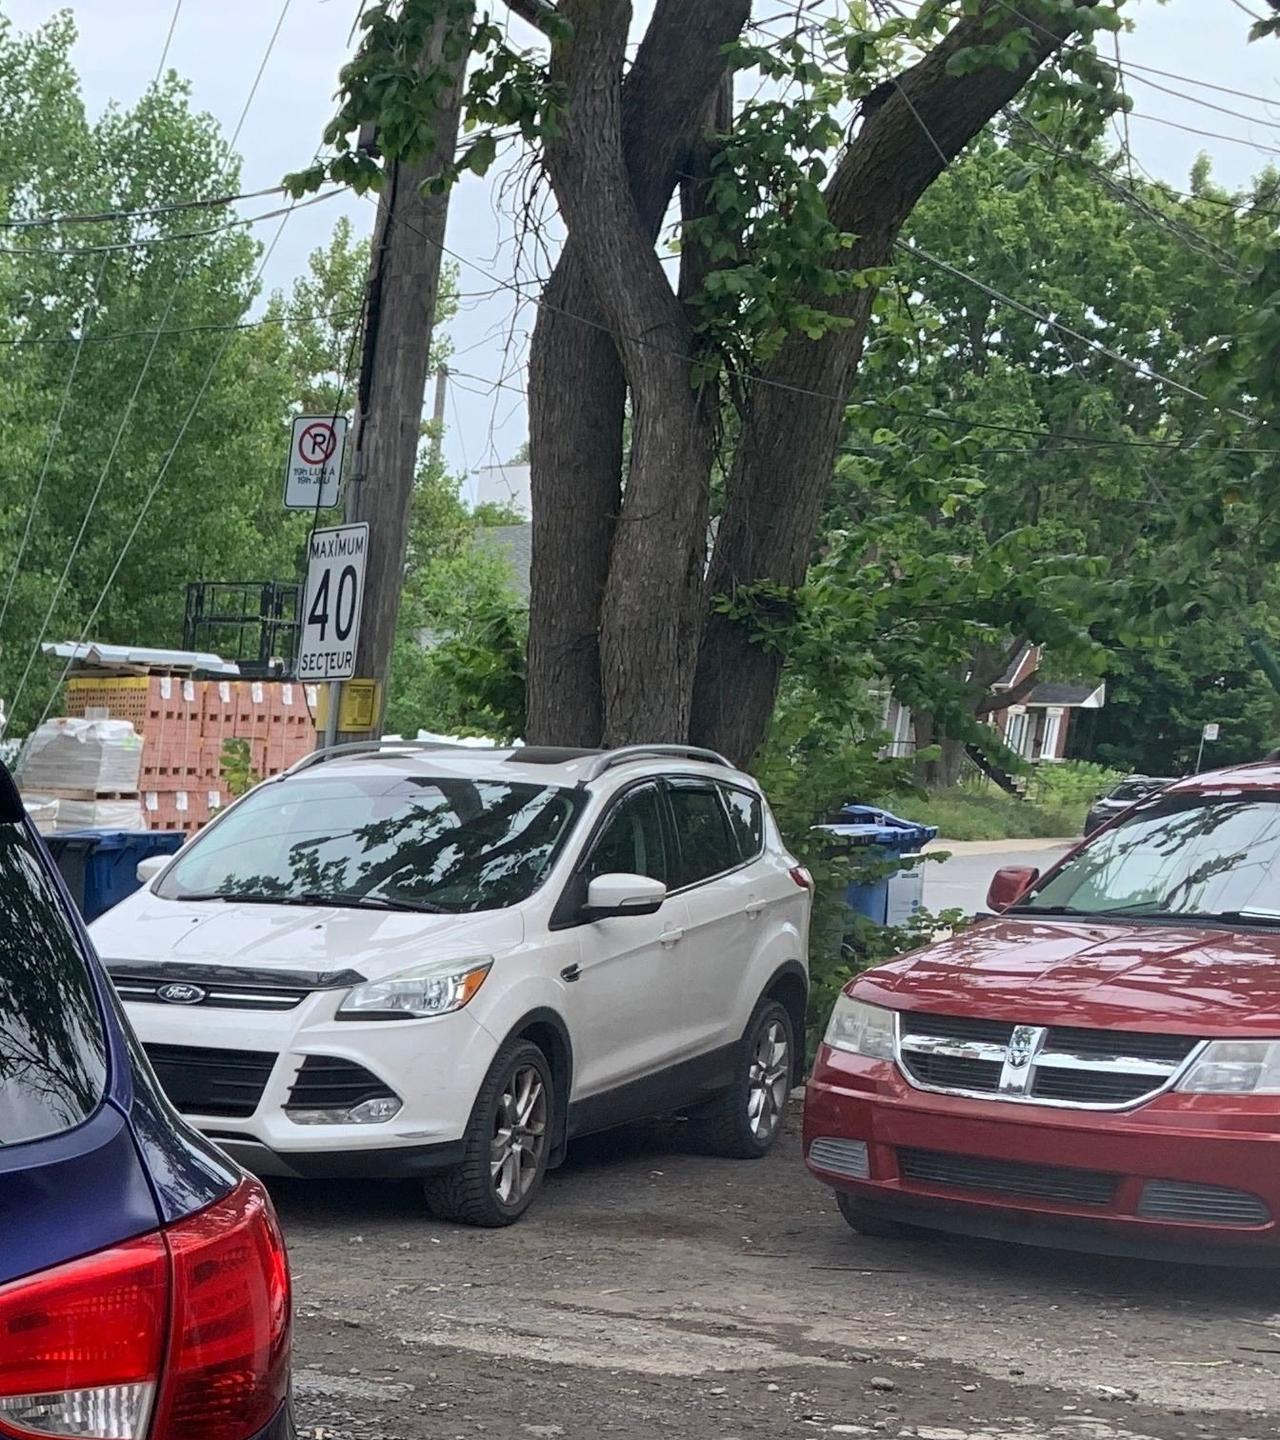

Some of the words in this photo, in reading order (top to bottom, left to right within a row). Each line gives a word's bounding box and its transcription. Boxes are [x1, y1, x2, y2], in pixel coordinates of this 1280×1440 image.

[311, 433, 326, 455] P
[311, 536, 364, 560] MAXIMUM
[308, 565, 358, 641] 40
[301, 651, 353, 672] SECTEUR
[165, 985, 193, 999] Ford
